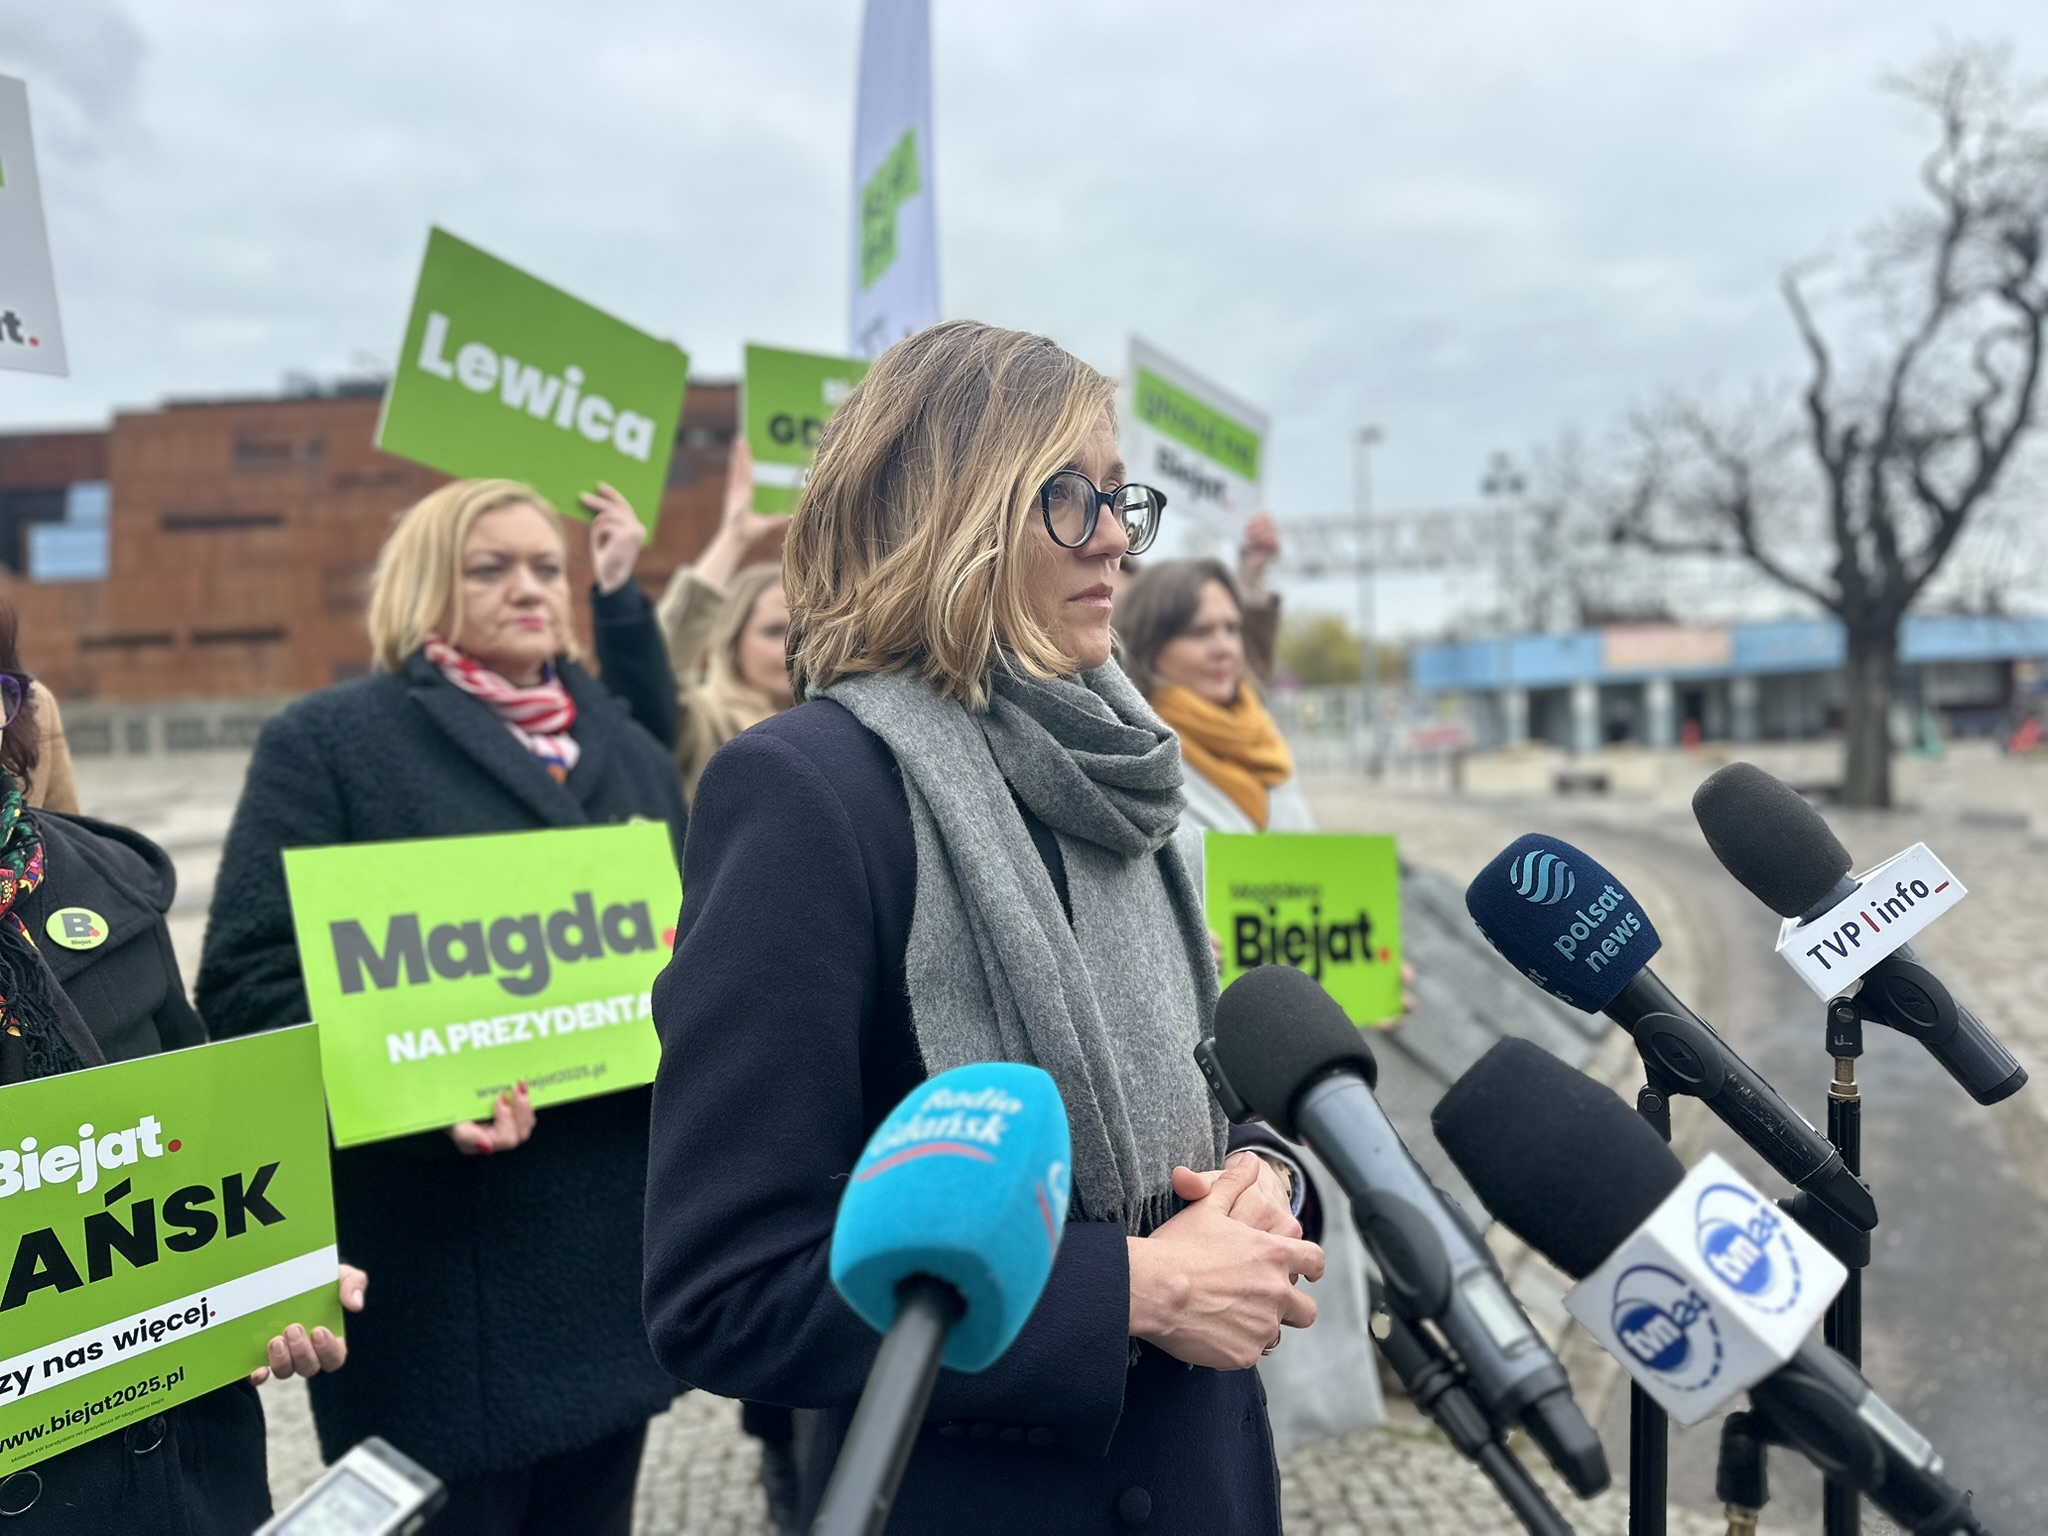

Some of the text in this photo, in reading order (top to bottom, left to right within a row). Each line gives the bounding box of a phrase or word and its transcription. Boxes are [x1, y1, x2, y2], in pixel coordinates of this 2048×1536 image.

[418, 310, 656, 462] Lewica
[329, 890, 676, 997] Magda.
[1234, 905, 1391, 983] Biejat.
[1553, 884, 1624, 962] polsat
[1585, 912, 1641, 973] news
[1806, 921, 1861, 970] TVP
[386, 1026, 446, 1064] NA
[43, 1341, 104, 1379] nas
[112, 1297, 216, 1351] więcej.
[0, 1366, 185, 1453] ww.biejat2025.pl
